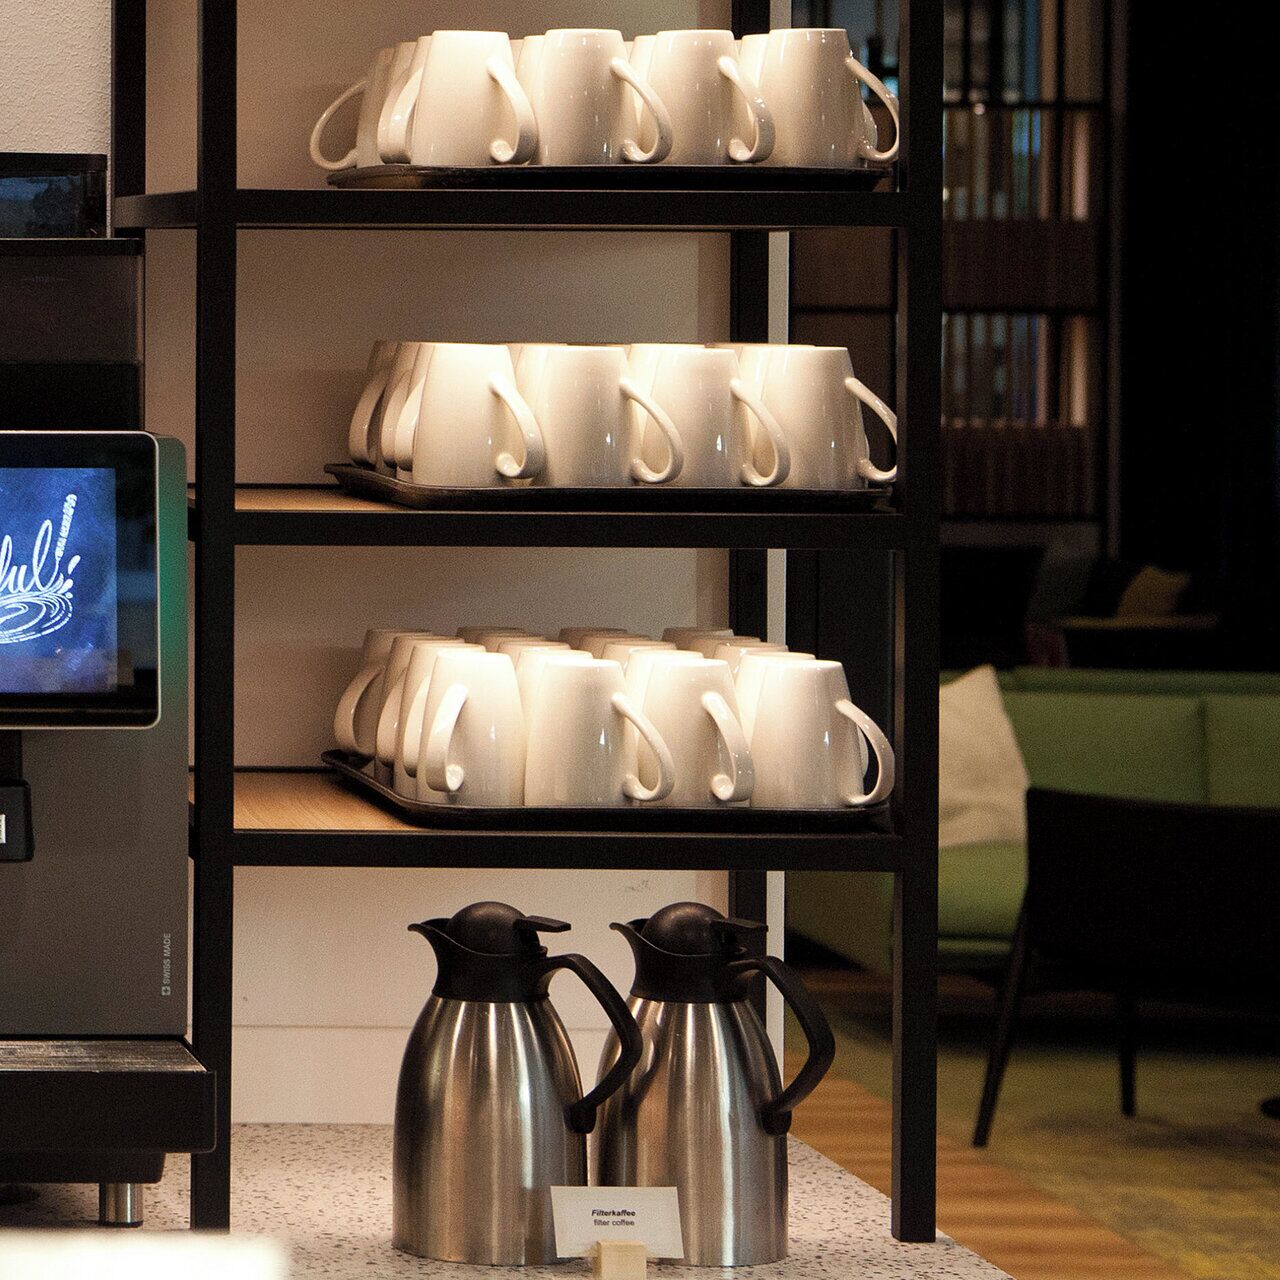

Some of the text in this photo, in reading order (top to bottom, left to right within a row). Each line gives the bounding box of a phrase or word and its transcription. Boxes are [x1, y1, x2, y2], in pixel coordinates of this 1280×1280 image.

[162, 933, 172, 985] SWISS MADE
[591, 1209, 636, 1217] Filterkaffee
